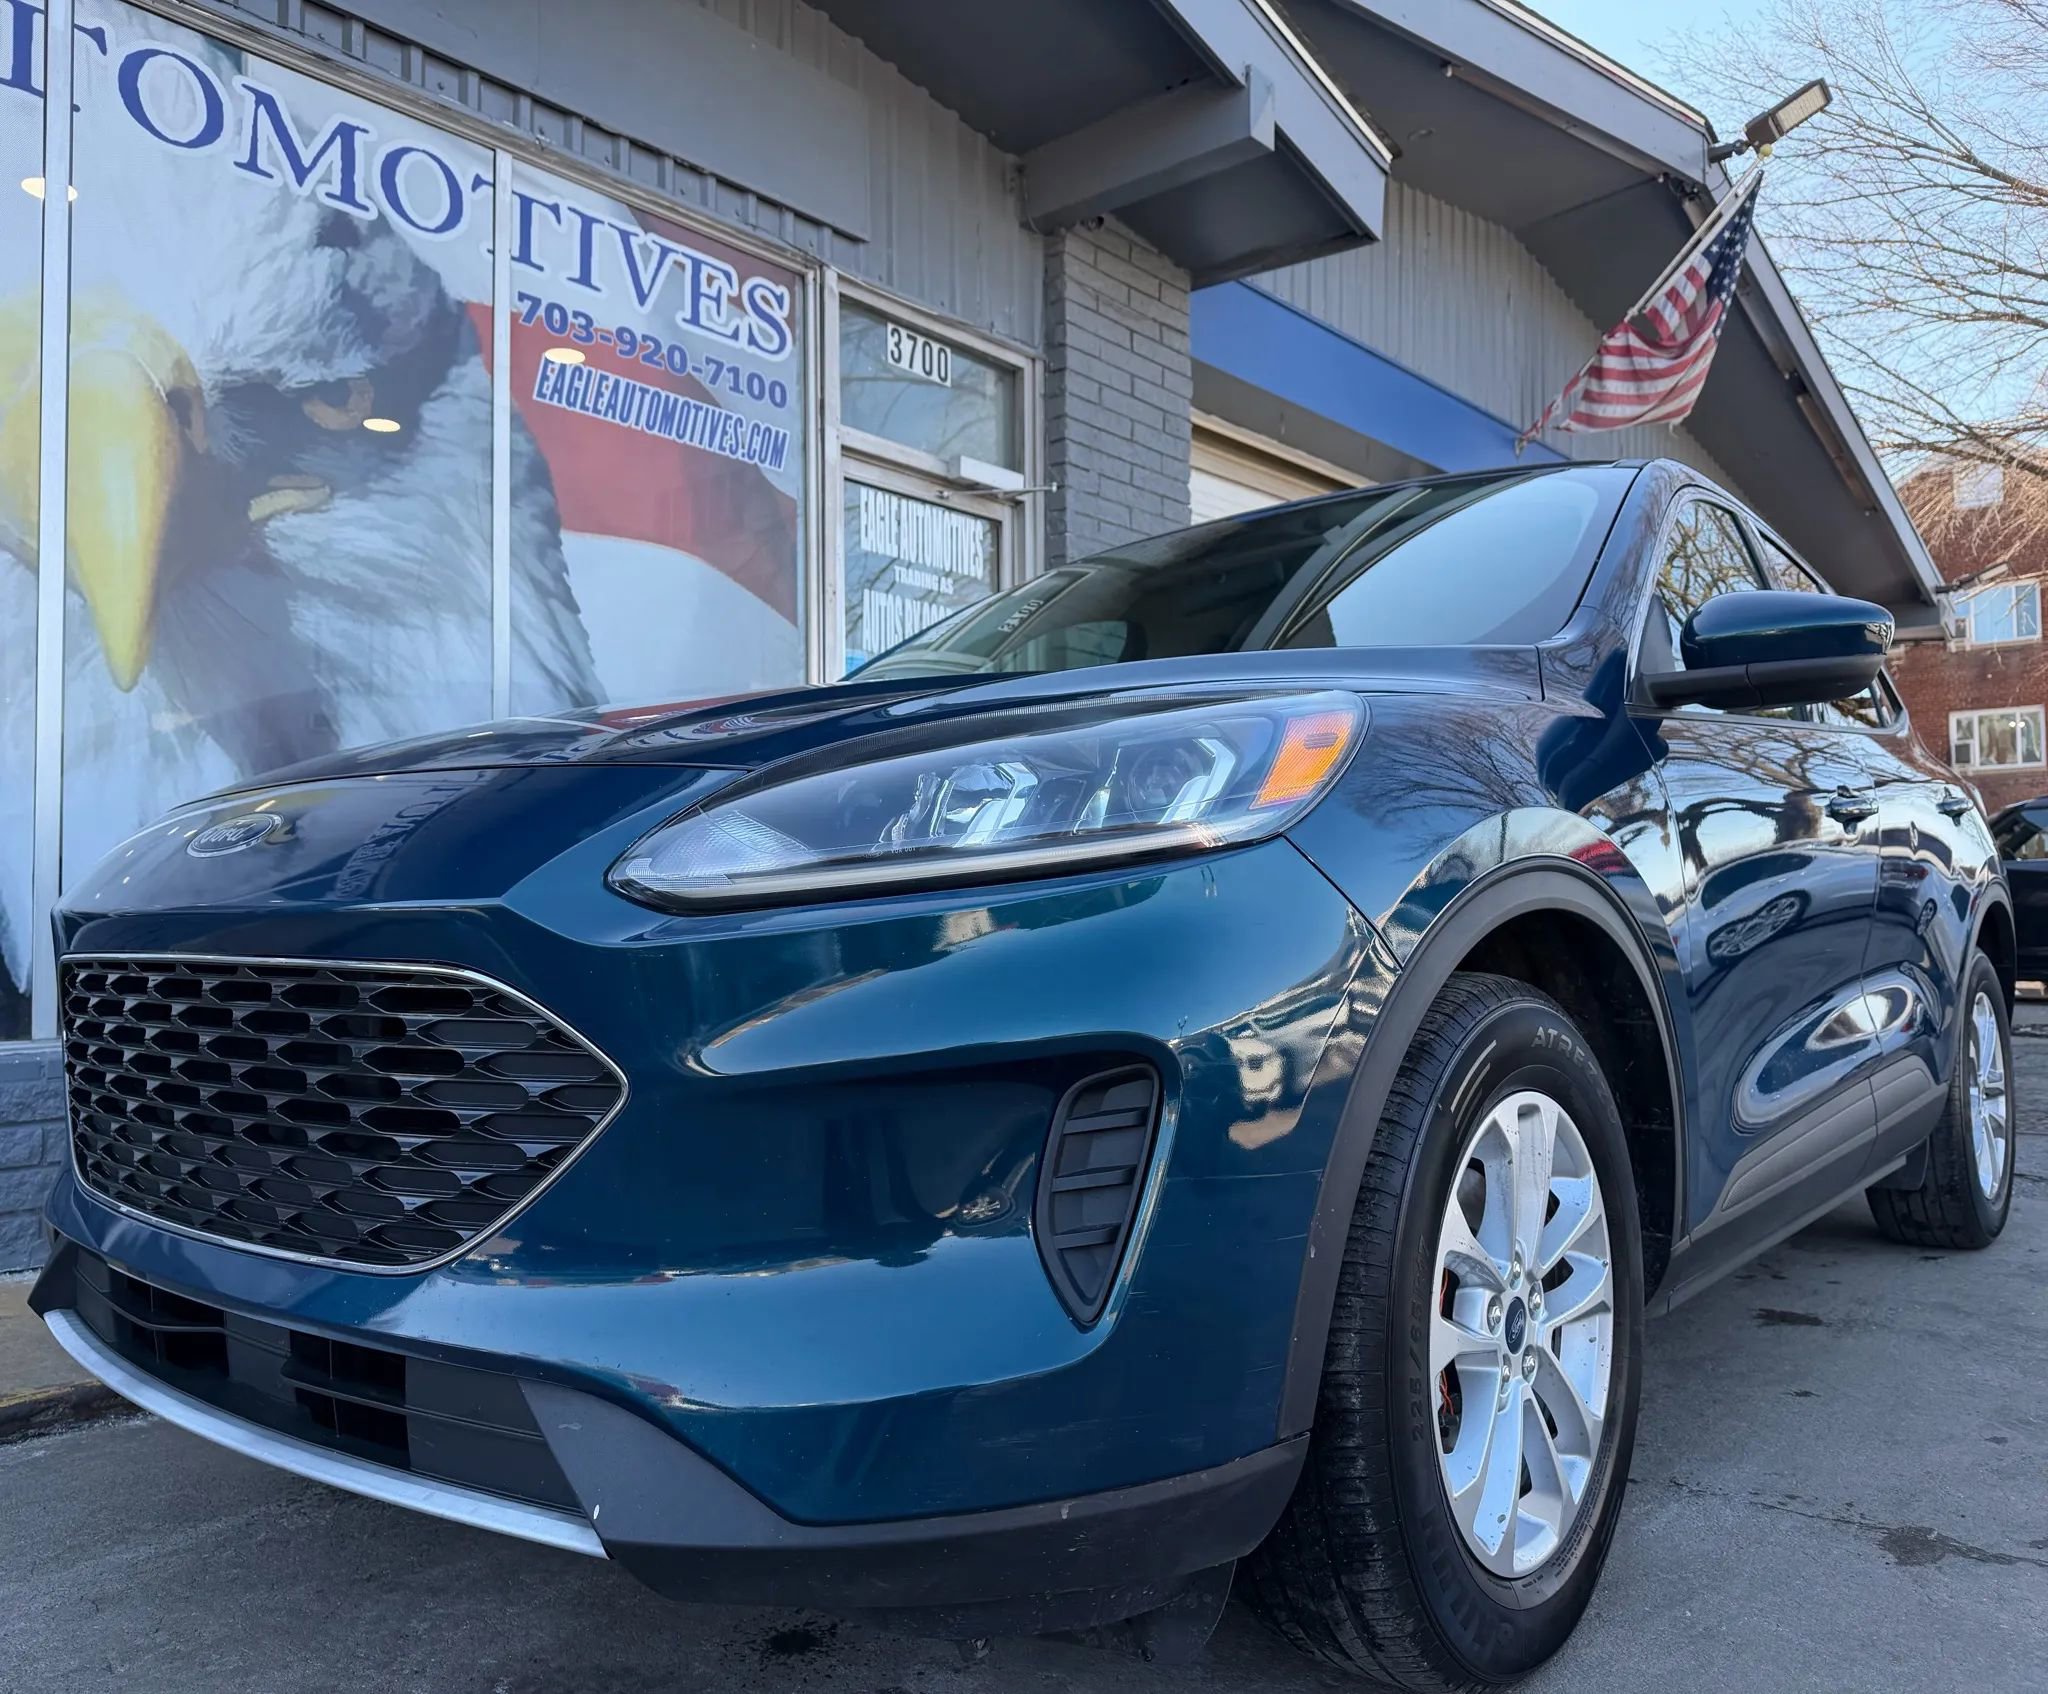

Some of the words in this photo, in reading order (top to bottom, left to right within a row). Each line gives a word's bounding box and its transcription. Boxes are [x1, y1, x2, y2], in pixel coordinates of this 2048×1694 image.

[516, 290, 789, 410] 703-920-7100
[889, 326, 950, 384] 3700
[534, 357, 789, 471] EAGLEAUTOMOTIVES.COM
[860, 486, 899, 559] EAGLE
[899, 498, 984, 581] AUTOMOTIVES
[894, 565, 940, 593] TRADING
[940, 575, 954, 595] AS
[862, 588, 904, 655] AUTOS
